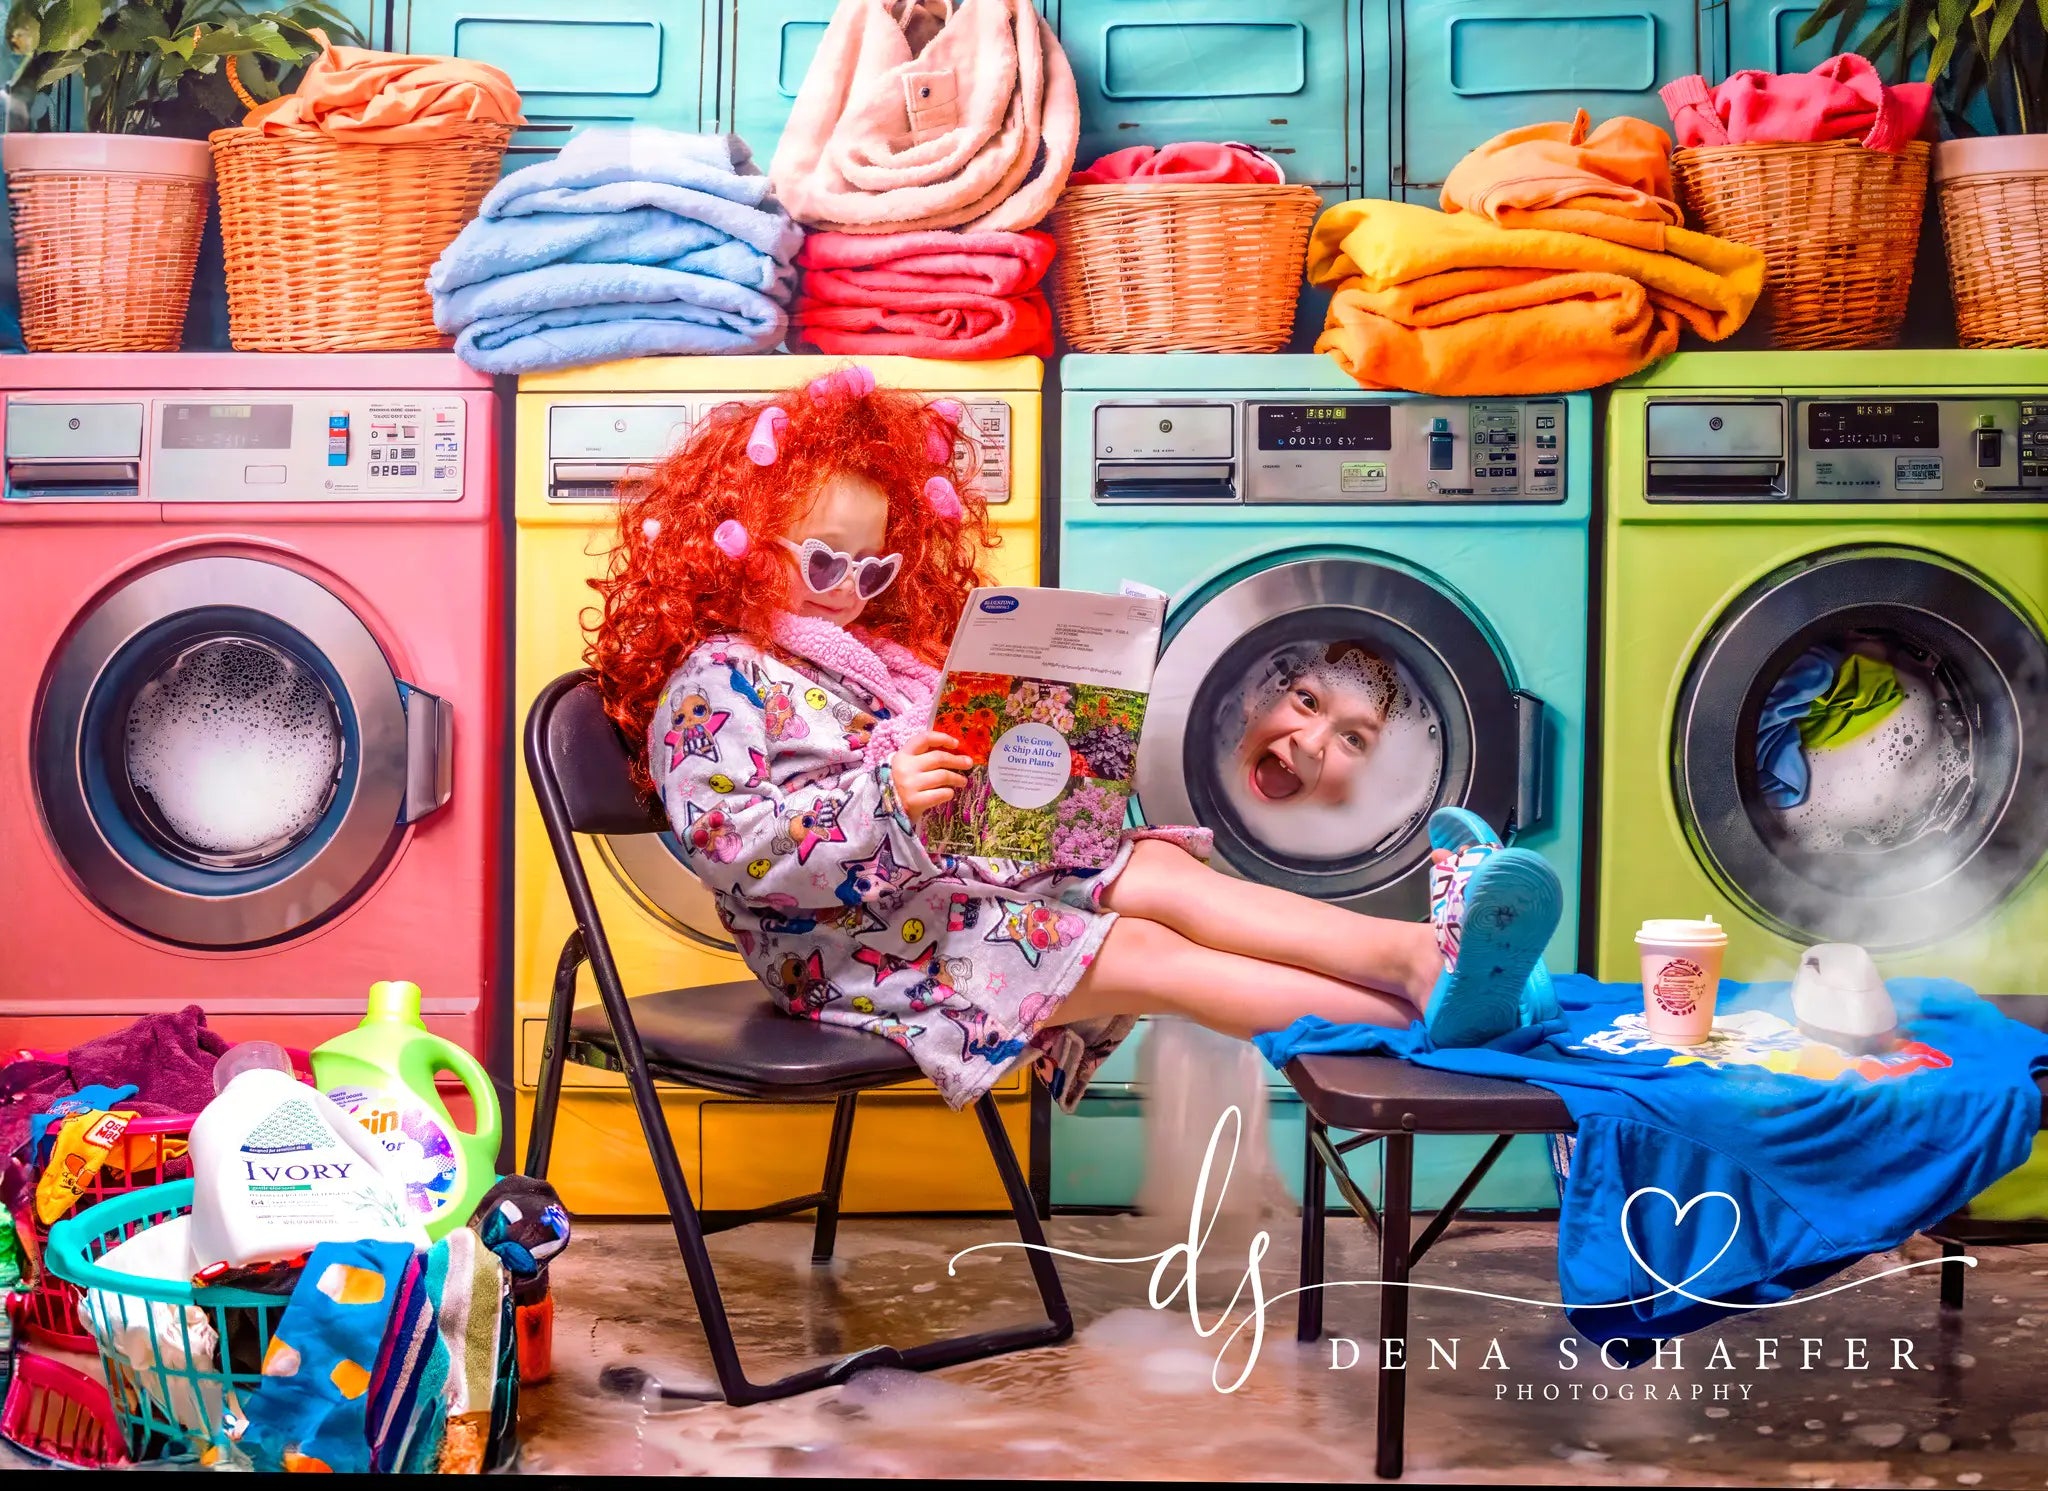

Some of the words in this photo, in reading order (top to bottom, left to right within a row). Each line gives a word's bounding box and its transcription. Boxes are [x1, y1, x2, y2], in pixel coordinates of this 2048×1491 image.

[1016, 735, 1030, 744] We
[1030, 736, 1053, 747] Grow
[1003, 744, 1011, 752] &
[1012, 745, 1031, 756] Ship
[1032, 748, 1045, 756] All
[1045, 749, 1062, 758] Our
[1007, 755, 1027, 765] Own
[1028, 757, 1054, 768] Plants
